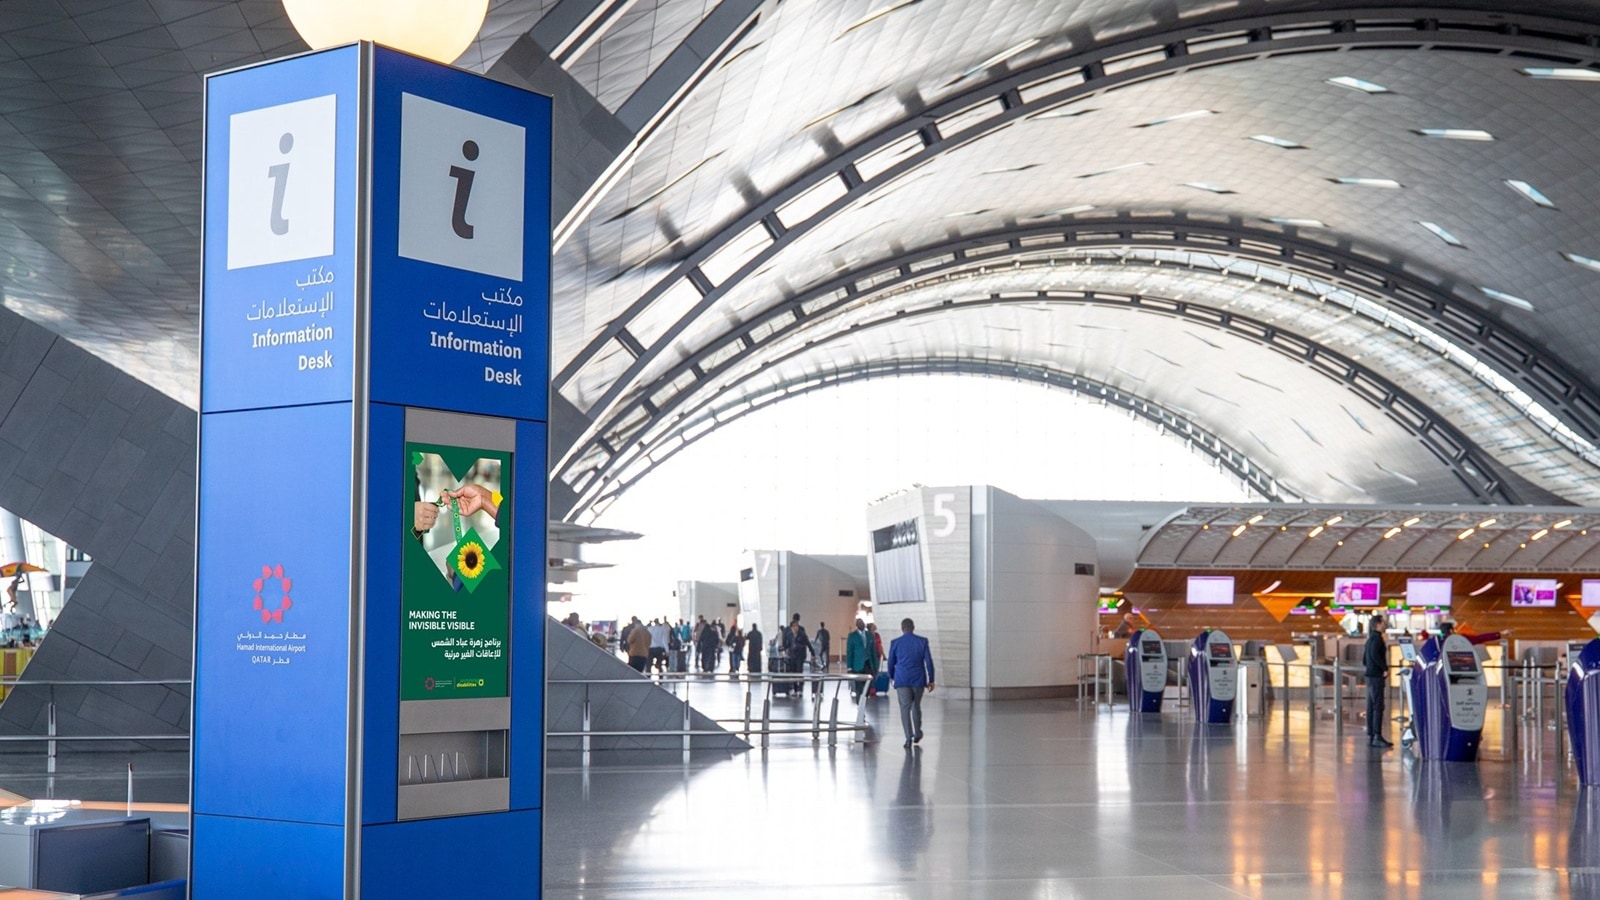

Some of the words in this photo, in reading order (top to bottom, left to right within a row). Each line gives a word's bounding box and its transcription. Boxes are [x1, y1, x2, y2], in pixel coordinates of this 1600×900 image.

[295, 265, 334, 288] مكتب
[246, 291, 334, 322] الإستعلامات
[481, 287, 523, 307] مكتب
[423, 301, 523, 337] الإستعلامات
[252, 325, 333, 349] Information
[430, 331, 522, 360] Information
[298, 350, 333, 371] Desk
[484, 367, 522, 386] Desk
[934, 493, 957, 538] 5
[759, 553, 772, 578] 7
[408, 610, 441, 620] MAKING
[441, 611, 458, 620] THE
[408, 621, 446, 631] INVISIBLE
[446, 621, 476, 631] VISIBLE
[236, 643, 255, 651] Hamad
[255, 644, 288, 652] International
[288, 645, 306, 653] Airport
[431, 637, 455, 648] الشمس
[455, 638, 468, 648] عباد
[469, 638, 483, 649] زهرة
[484, 637, 502, 648] برنامج
[251, 656, 271, 664] QATAR
[475, 649, 502, 660] للإعاقات
